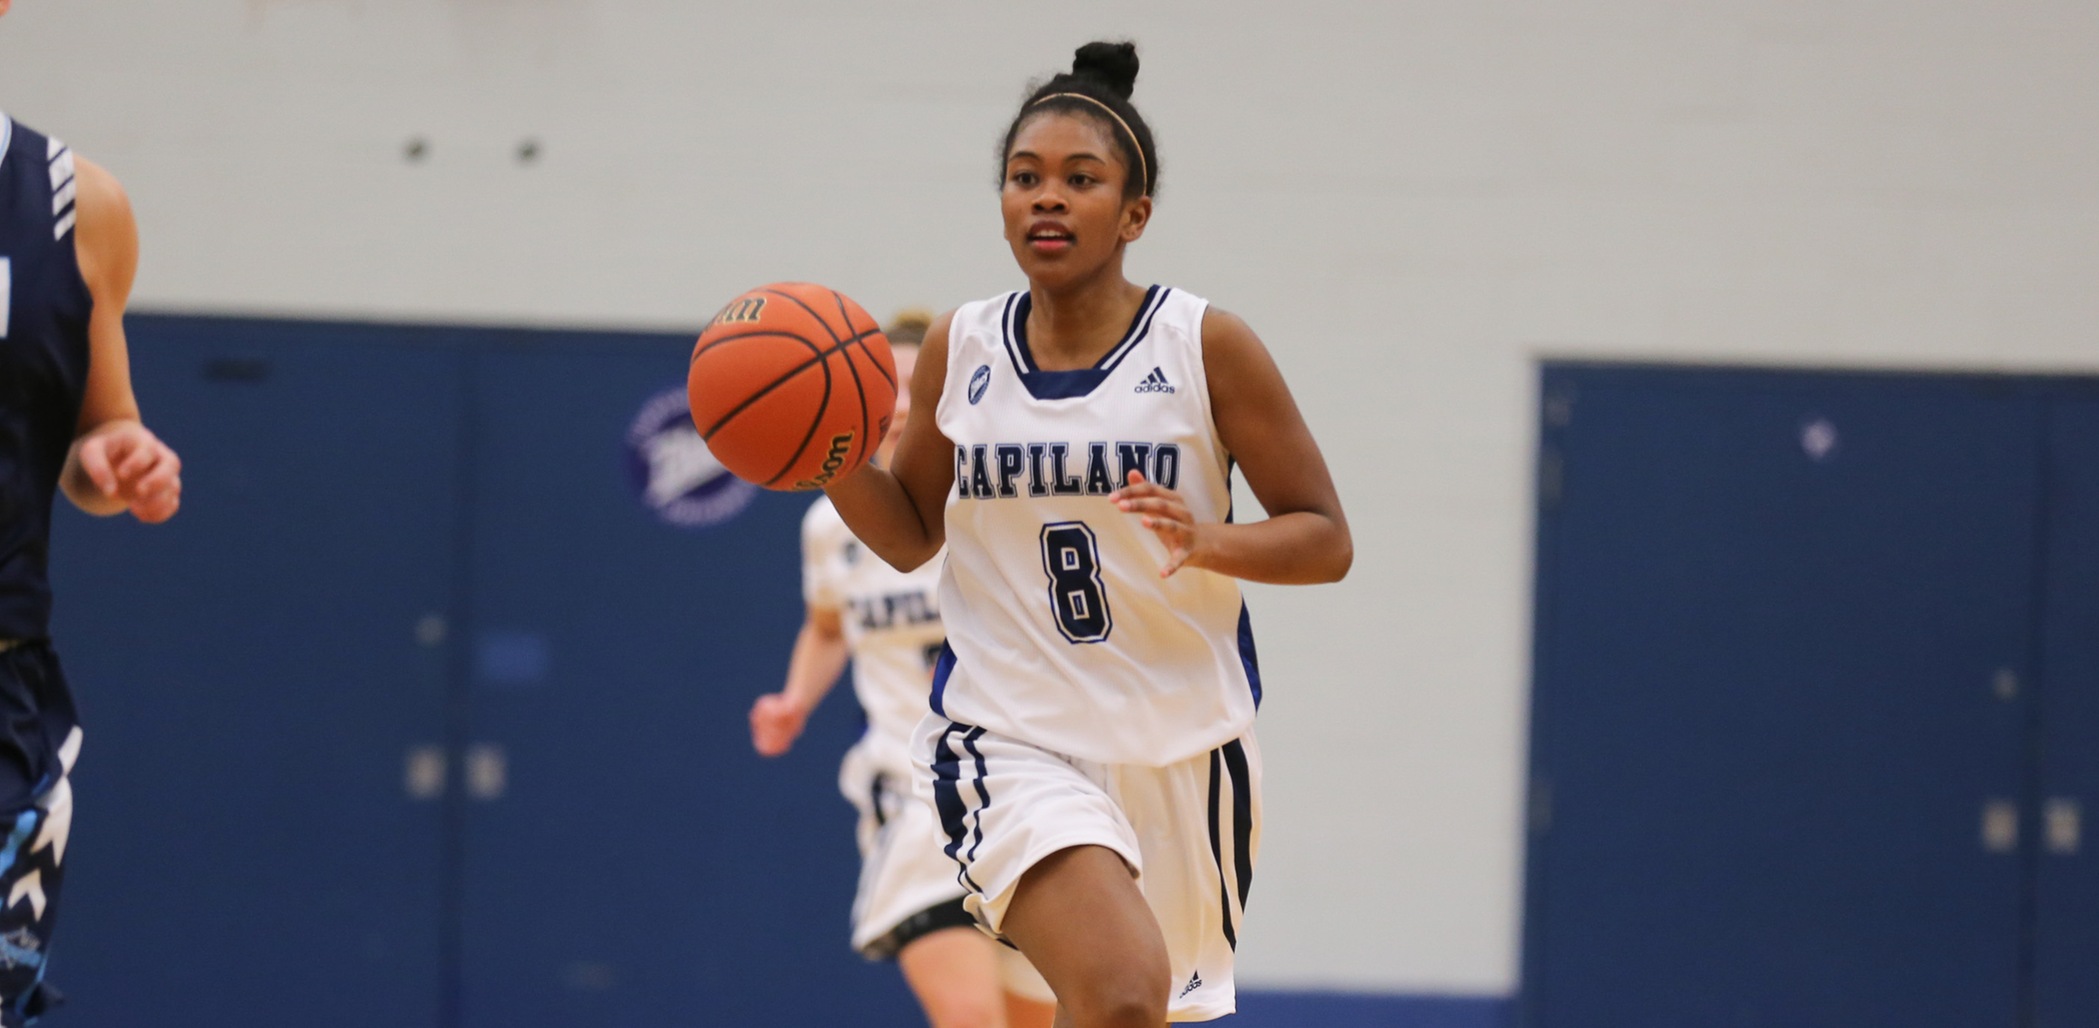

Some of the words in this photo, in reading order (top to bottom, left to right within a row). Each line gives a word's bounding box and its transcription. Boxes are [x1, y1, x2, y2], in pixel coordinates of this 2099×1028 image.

[1134, 383, 1175, 394] adidas
[957, 442, 1181, 499] CAPILANO
[1040, 521, 1112, 644] 8
